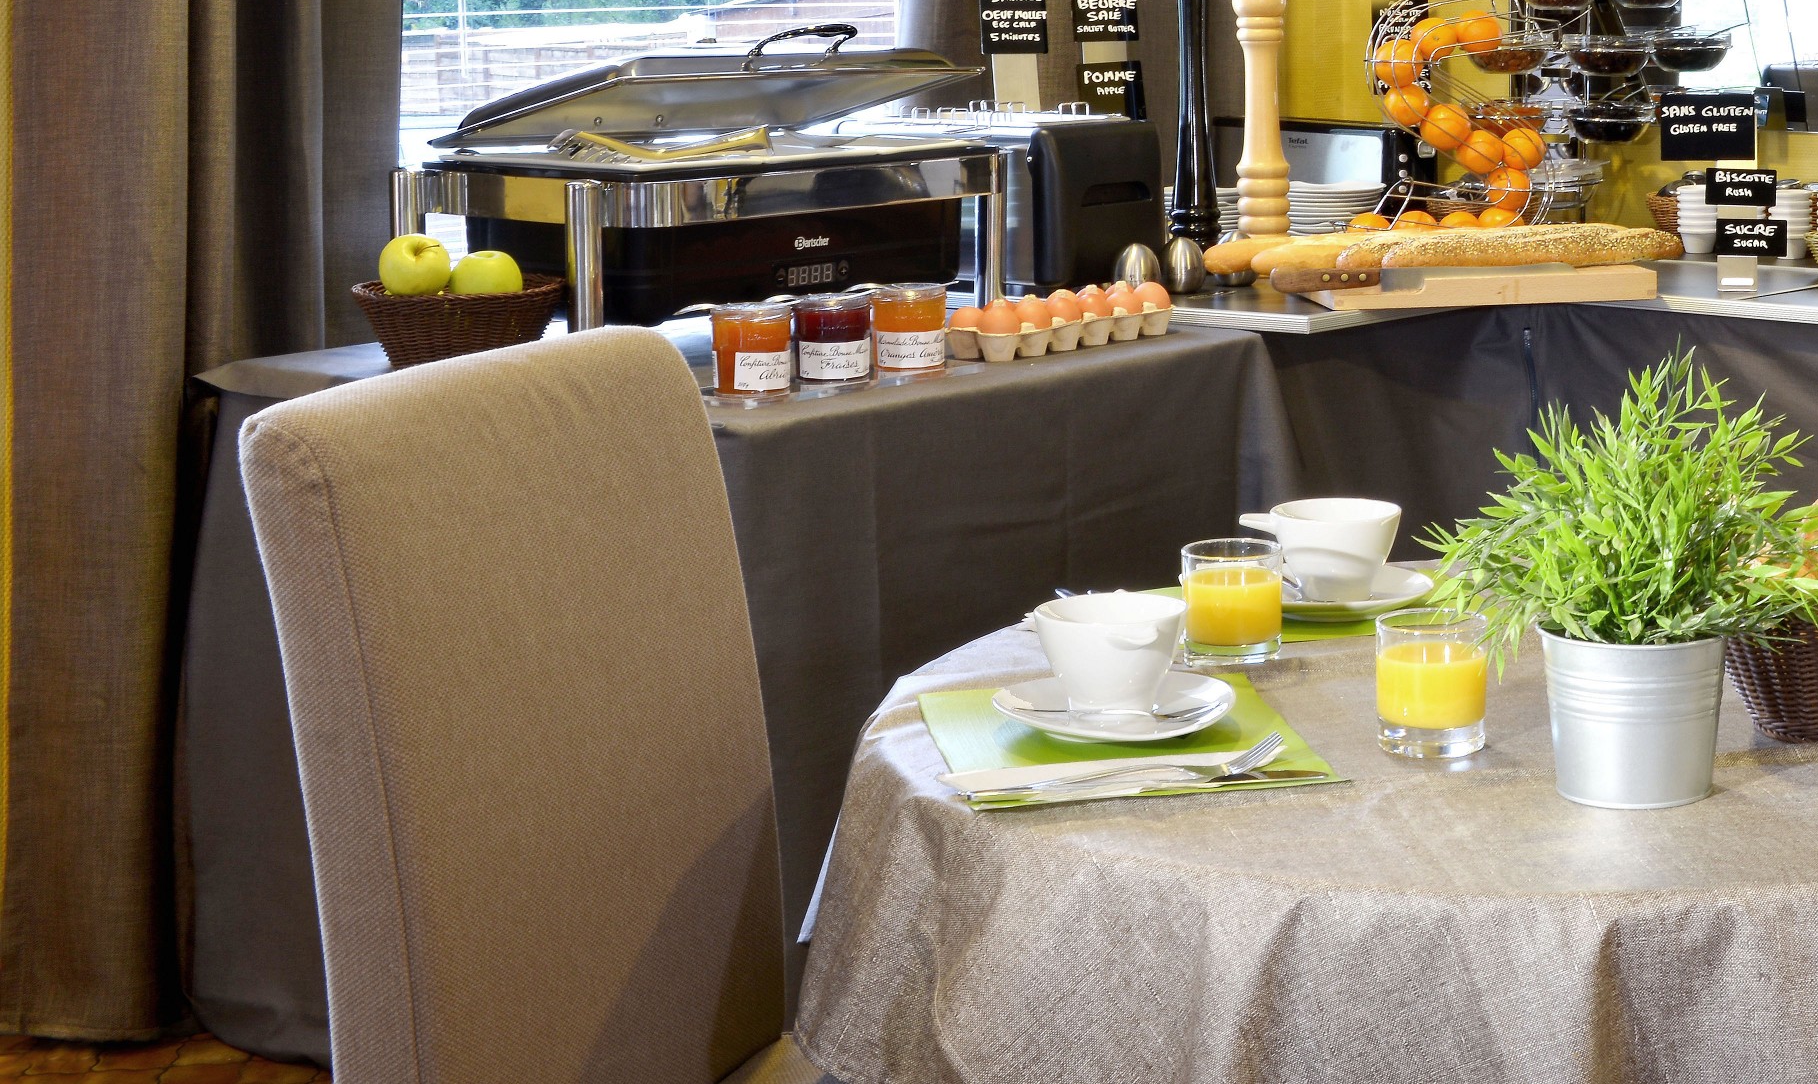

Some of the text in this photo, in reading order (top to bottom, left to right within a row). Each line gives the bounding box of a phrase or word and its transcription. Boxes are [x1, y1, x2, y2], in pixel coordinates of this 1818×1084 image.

[982, 10, 1047, 21] OEUF MOLLET
[1087, 9, 1122, 22] SALÉ
[990, 33, 999, 42] 5
[1083, 70, 1136, 85] POMME
[1096, 86, 1126, 95] APPLE
[1661, 105, 1696, 118] SANS
[1701, 105, 1754, 117] GLUTEN
[1670, 123, 1737, 135] GLUTEN FREE
[1724, 224, 1778, 237] SUCRE
[794, 236, 830, 250] Bartscher
[1733, 238, 1769, 249] SUGAR
[880, 349, 916, 362] Oranges
[739, 356, 771, 369] Confiture
[820, 358, 861, 369] Fraises
